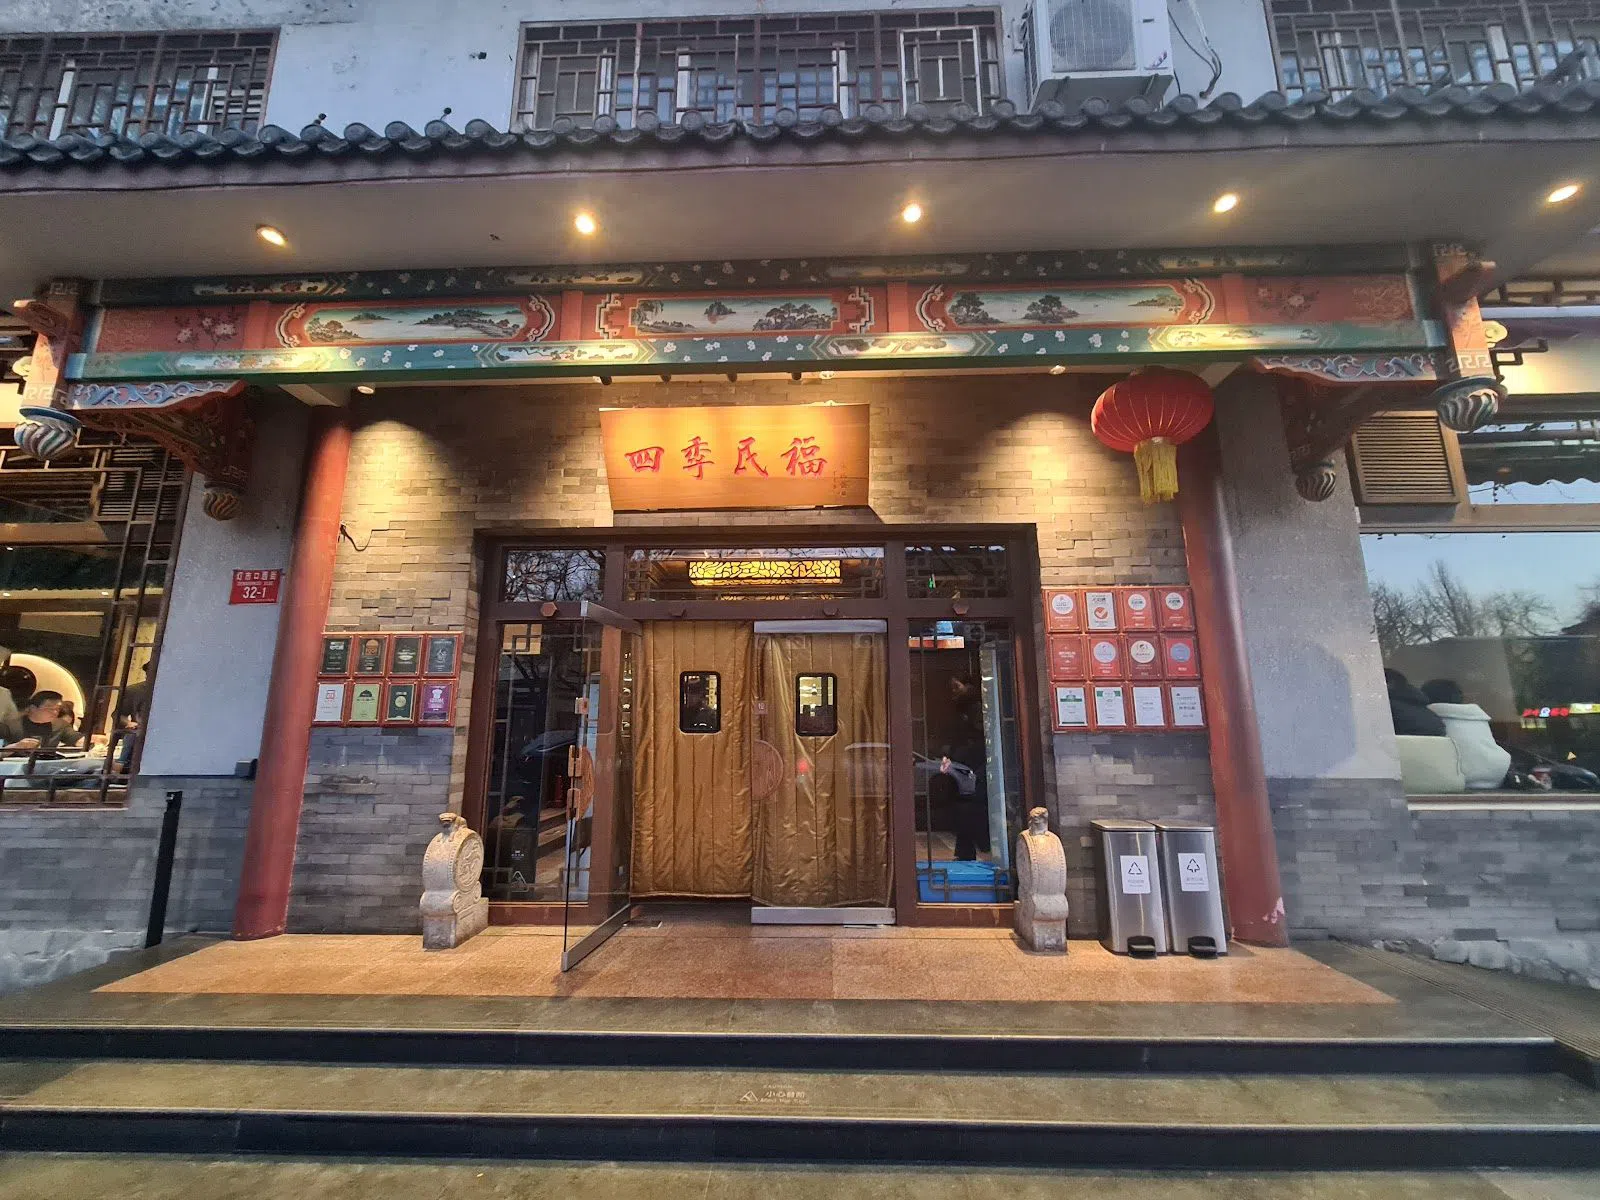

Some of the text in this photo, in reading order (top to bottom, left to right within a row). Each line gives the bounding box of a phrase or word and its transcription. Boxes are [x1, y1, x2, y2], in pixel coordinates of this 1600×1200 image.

[625, 436, 829, 480] 四季民福
[242, 586, 267, 599] 32-1
